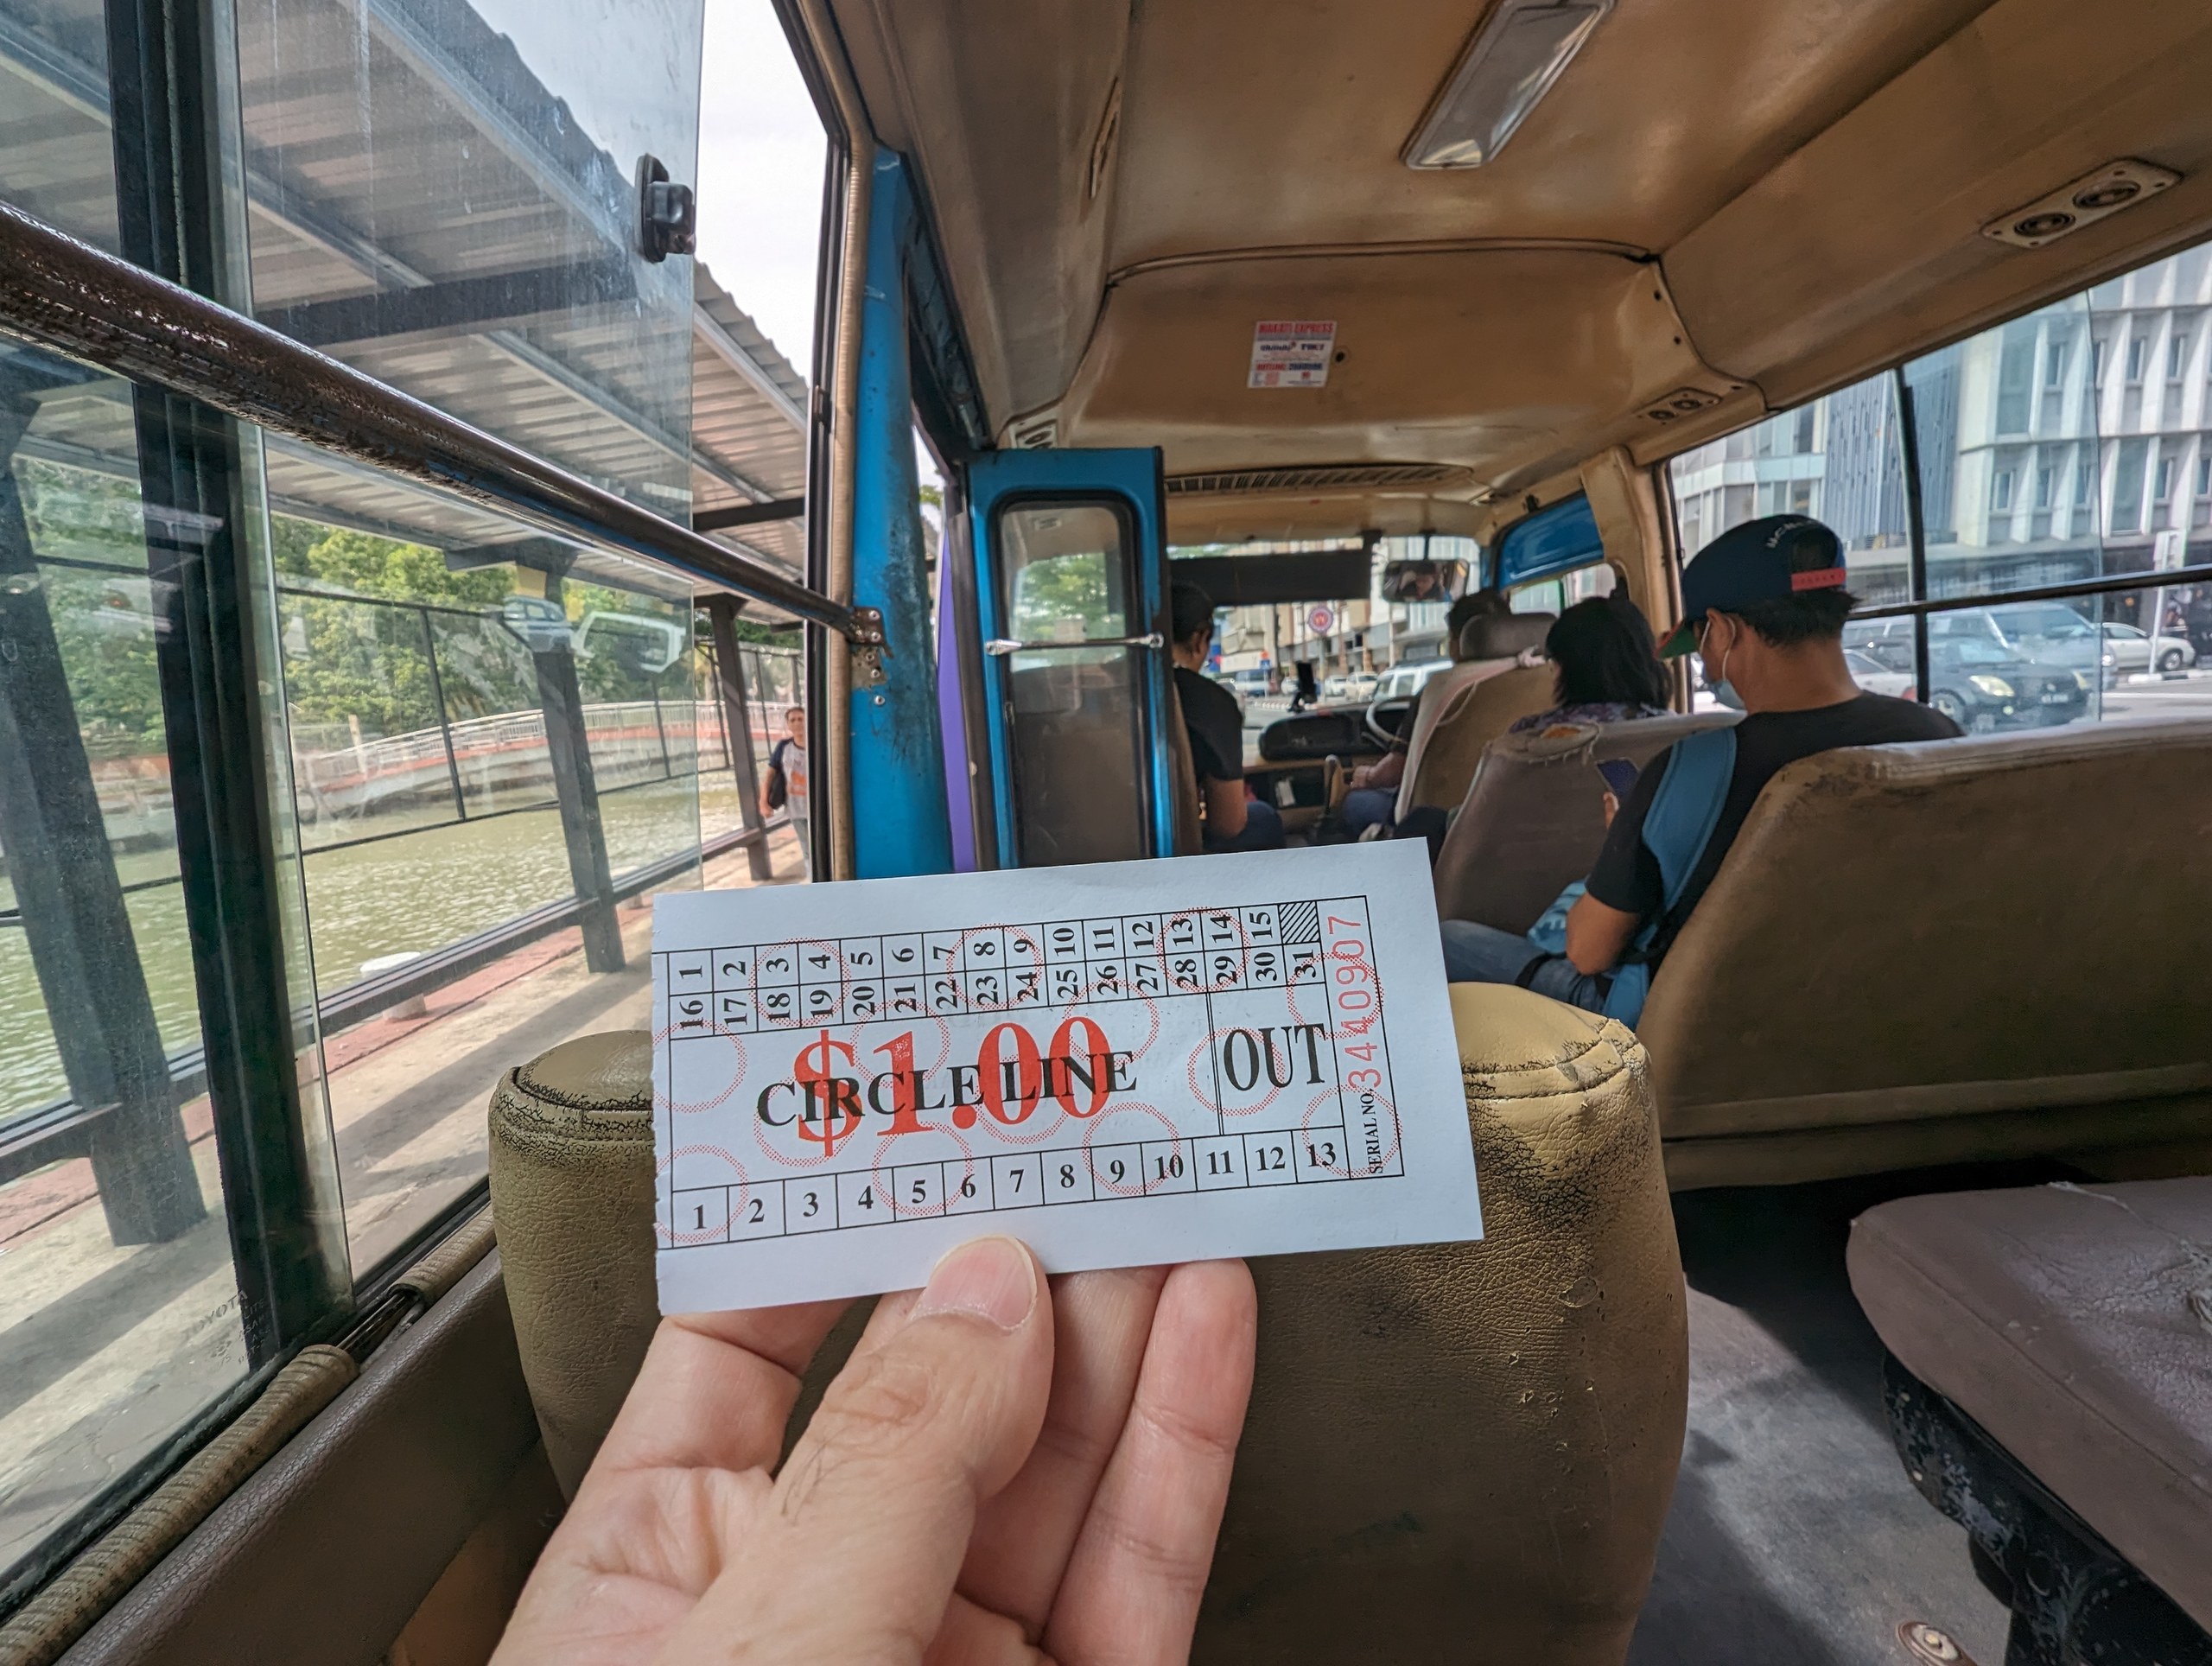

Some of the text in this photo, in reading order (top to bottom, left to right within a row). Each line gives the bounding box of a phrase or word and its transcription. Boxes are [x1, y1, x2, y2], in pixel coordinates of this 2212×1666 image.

[678, 912, 1273, 977] 1 2 3 4 5 6 7 8 9 10 11 12 13 14 15
[679, 951, 1317, 1029] 16 17 18 19 20 21 22 23 24 25 26 27 28 29 30 31
[1329, 916, 1382, 1089] 3440907
[757, 1051, 1136, 1126] CIRCLE LINE
[793, 1015, 1112, 1157] $1.00
[1223, 1022, 1326, 1091] OUT
[1363, 1118, 1383, 1173] SERIAL
[695, 1142, 1337, 1230] 1 2 3 4 5 6 7 8 9 10 11 12 13
